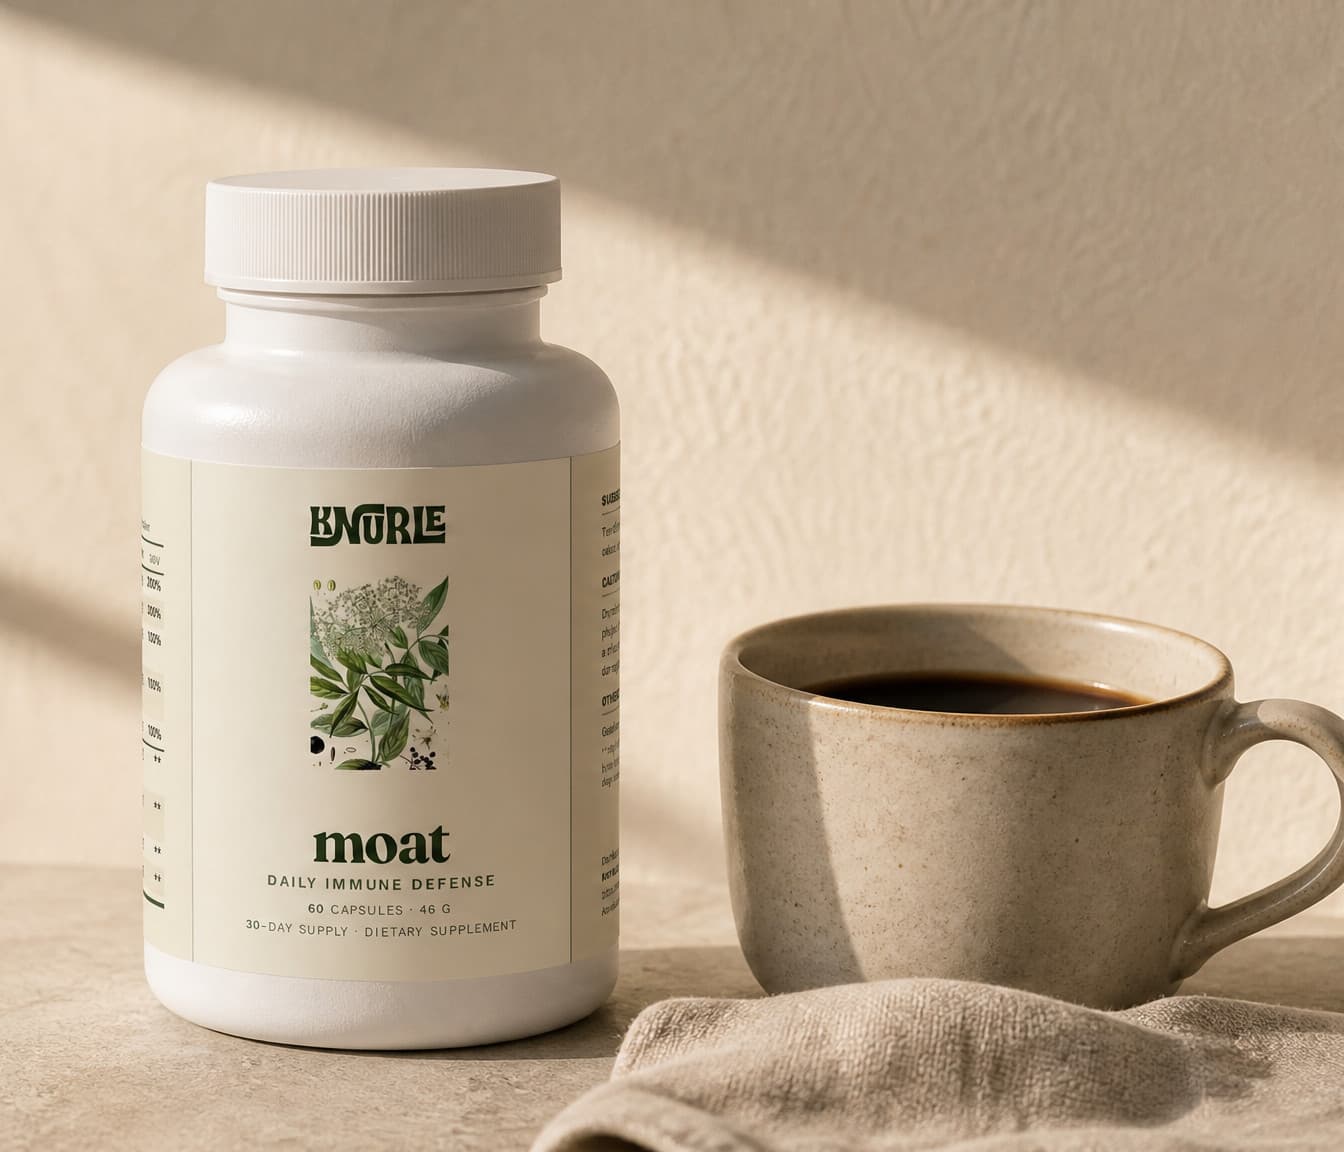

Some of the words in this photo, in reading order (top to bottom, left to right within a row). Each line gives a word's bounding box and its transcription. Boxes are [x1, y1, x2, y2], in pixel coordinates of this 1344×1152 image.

[309, 503, 446, 547] KNURLE
[313, 825, 451, 864] moat
[267, 874, 317, 889] DAILY
[325, 877, 402, 891] IMMUNE
[411, 874, 496, 891] DEFENSE
[308, 903, 324, 915] 60
[330, 904, 403, 916] CAPSULES
[419, 904, 436, 915] 46
[441, 904, 451, 915] G
[246, 919, 292, 934] 30-DAY
[299, 924, 348, 937] SUPPLY
[364, 926, 423, 938] DIETARY
[430, 919, 517, 937] SUPPLEMENT
